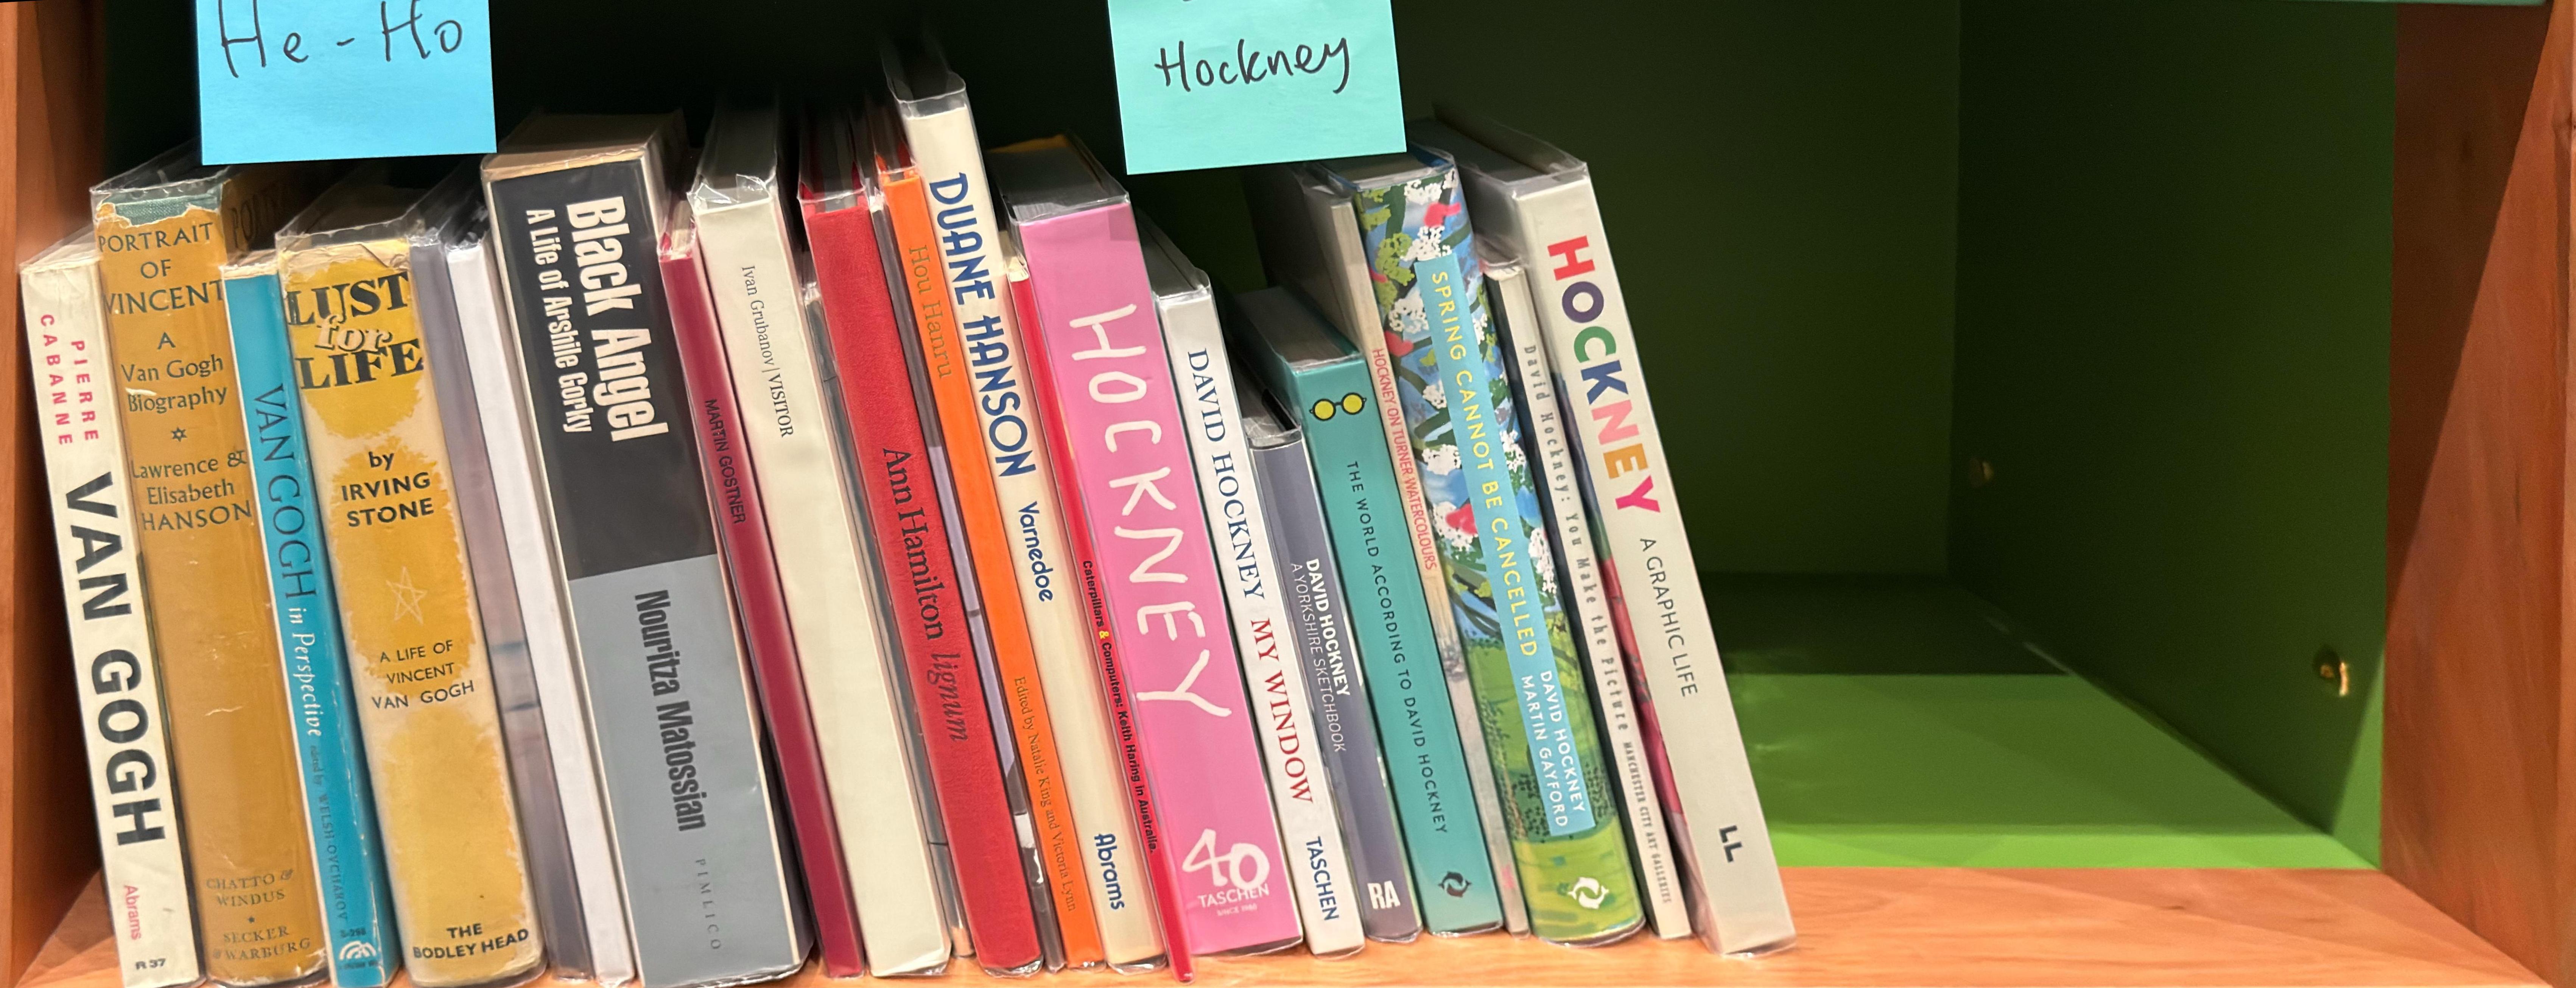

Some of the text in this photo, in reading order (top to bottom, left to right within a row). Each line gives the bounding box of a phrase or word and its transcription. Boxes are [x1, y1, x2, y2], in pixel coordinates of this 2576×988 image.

[218, 0, 462, 78] He - Ho
[1154, 37, 1350, 94] Hockney
[98, 222, 213, 252] PORTRAIT
[140, 259, 171, 279] OF
[106, 279, 223, 315] VINCENT
[286, 271, 409, 325] LUST
[315, 314, 392, 352] for
[526, 209, 594, 433] A Life of Arshile Gorky
[567, 196, 669, 442] Black Angel
[909, 245, 952, 379] Hou Hanru
[929, 172, 1037, 477] DUANE HANSON
[40, 314, 72, 444] CABANNE
[121, 354, 224, 382] Van Gogh
[157, 332, 176, 349] A
[294, 338, 424, 389] LIFE
[741, 266, 758, 296] Ivan
[750, 299, 774, 366] Grubanov
[768, 373, 794, 438] VISITOR
[1547, 235, 1661, 515] HOCKNEY
[72, 340, 98, 440] PIERRE
[128, 386, 227, 413] Biography
[254, 383, 294, 462] VAN
[131, 450, 247, 479] Lawrence &
[147, 479, 235, 505] Elisabeth
[342, 472, 431, 501] IRVING
[369, 451, 394, 470] by
[705, 399, 746, 524] MARTIN GOSTNER
[1373, 348, 1438, 571] HOCKNEY ON TURNER WATERCOLOURS
[1432, 270, 1538, 657] SPRING CANNOT BE CANCELLED
[143, 500, 253, 531] HANSON
[268, 474, 317, 599] GOGH
[347, 497, 434, 527] STONE
[1069, 303, 1232, 717] HOCKNEY
[1017, 500, 1053, 602] Varnedoe
[1188, 348, 1313, 804] DAVID HOCKNEY MY WINDOW
[288, 608, 307, 624] in
[883, 447, 969, 742] Ann Hamilton lignum
[1306, 558, 1351, 696] DAVID HOCKNEY
[1524, 345, 1672, 904] David Hockney: You Make the Picture MANCHESTER CITY ART GALLERIES
[1640, 537, 1698, 698] A GRAPHIC LIFE
[65, 472, 166, 846] VAN GOGH
[292, 633, 323, 737] Perspective
[380, 639, 454, 663] A LIFE OF
[386, 662, 455, 684] VINCENT
[1290, 563, 1346, 752] A YORKSHIRE SKETCHBOOK
[1347, 461, 1448, 834] THE WORLD ACCORDING TO DAVID HOCKNEY
[372, 679, 474, 709] VAN GOGH
[635, 589, 707, 832] Nouritza Matossian
[1083, 560, 1157, 854] Caterpillars & Computers: Keith Haring in Australia.
[1521, 675, 1568, 828] MARTIN GAYFORD
[1540, 670, 1585, 813] DAVID HOCKNEY
[1014, 676, 1076, 912] Edited by Natalie King and Victoria Lynn
[207, 874, 275, 889] CHATTO
[1094, 833, 1125, 910] Abrams
[1182, 829, 1270, 890] 40
[1306, 836, 1339, 921] TASCHEN
[1719, 824, 1743, 863] LL
[124, 884, 143, 940] Abrams
[216, 889, 285, 906] WINDUS
[447, 923, 483, 939] THE
[695, 858, 722, 951] PIMLICO
[1197, 883, 1269, 908] TASCHEN
[1368, 880, 1401, 909] RA
[136, 957, 167, 970] R 37
[224, 926, 289, 944] SECKER
[413, 928, 529, 959] BODLEY HEAD
